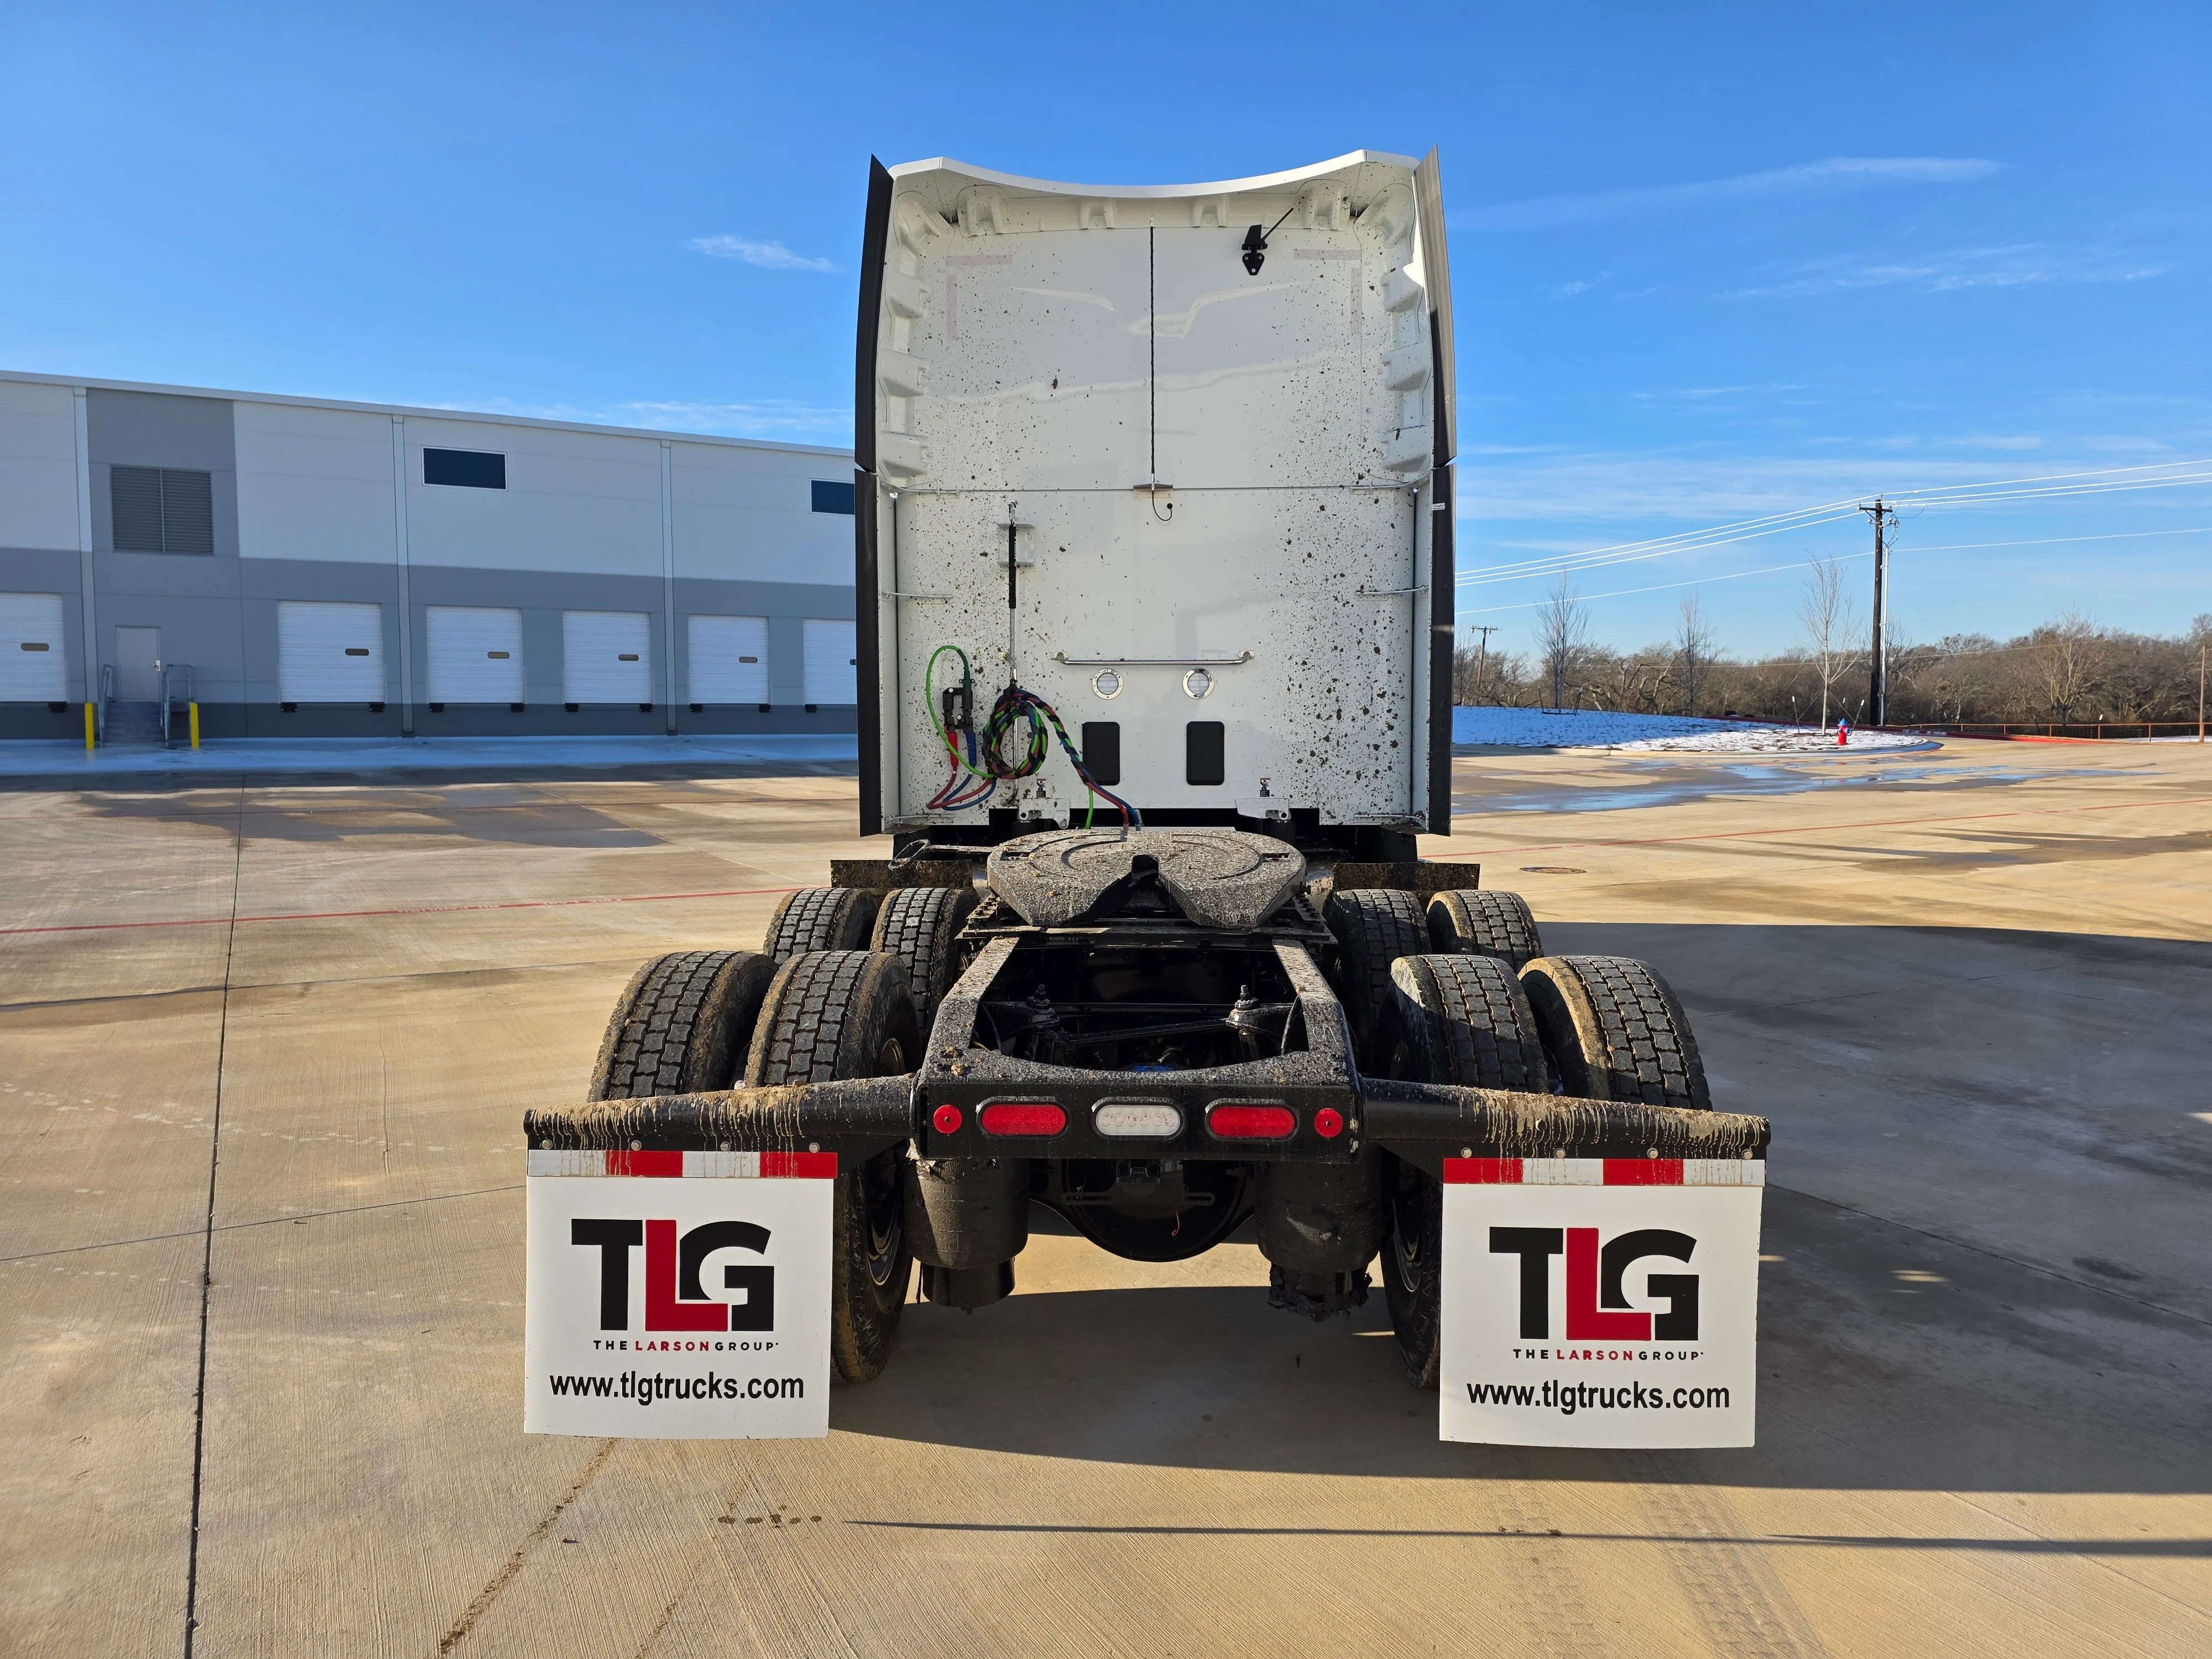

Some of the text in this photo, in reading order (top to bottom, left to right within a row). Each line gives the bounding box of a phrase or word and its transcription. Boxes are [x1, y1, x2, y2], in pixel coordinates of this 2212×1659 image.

[571, 1219, 774, 1332] TLG
[1489, 1227, 1699, 1341] TLG
[593, 1340, 774, 1352] THE LARSON GROUP
[1512, 1349, 1699, 1361] THE LARSON GROUP
[550, 1371, 804, 1406] www.tlgtrucks.com
[1467, 1380, 1729, 1415] www.tlgtrucks.com
